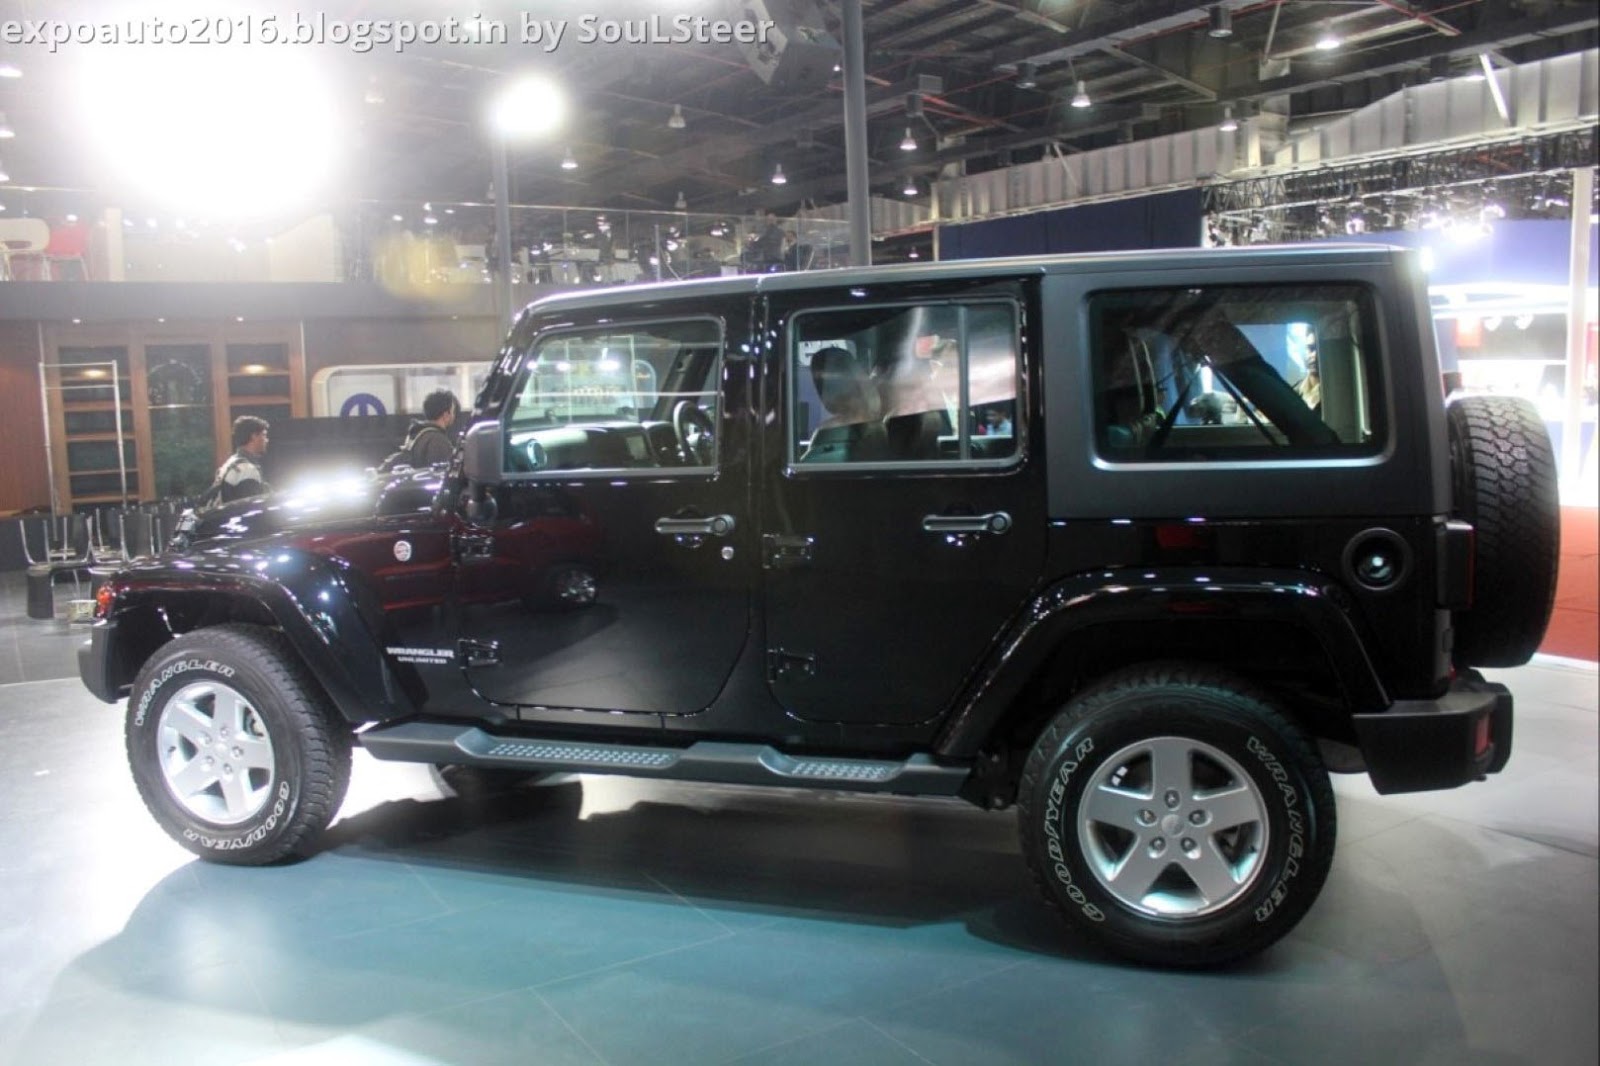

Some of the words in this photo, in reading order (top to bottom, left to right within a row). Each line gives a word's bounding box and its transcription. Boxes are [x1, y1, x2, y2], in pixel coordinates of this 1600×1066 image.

[386, 647, 455, 659] WRANGLER
[397, 656, 448, 665] UNLIMITED
[134, 659, 235, 727] WRANGLER
[1247, 736, 1304, 922] WRANGLER
